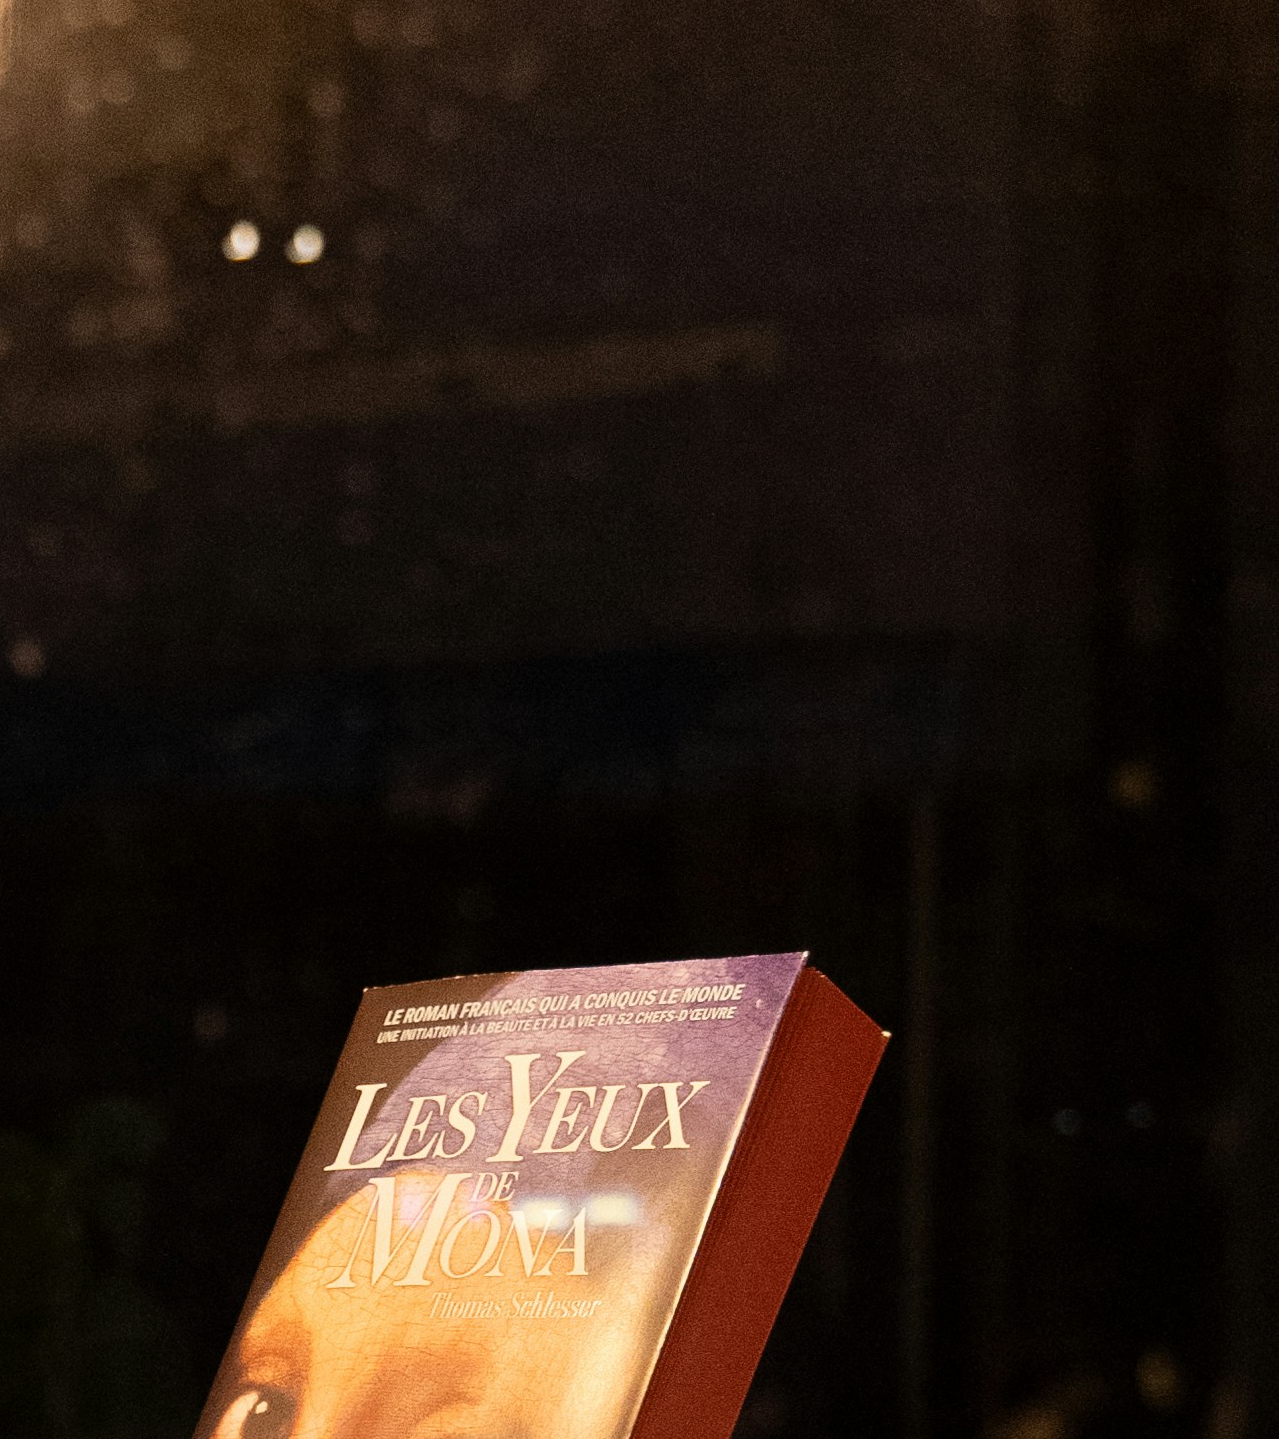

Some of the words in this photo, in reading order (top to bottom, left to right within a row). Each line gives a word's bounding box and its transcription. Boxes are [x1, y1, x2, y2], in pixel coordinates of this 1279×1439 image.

[383, 1008, 405, 1026] LE
[404, 1003, 458, 1025] ROMAN
[459, 997, 538, 1020] FRANÇAIS
[539, 994, 568, 1013] QUI
[570, 994, 583, 1011] A
[584, 989, 657, 1009] CONQUIS
[658, 988, 680, 1006] LE
[680, 983, 745, 1004] MONDE
[376, 1029, 399, 1044] UNE
[399, 1023, 458, 1042] INITIATION
[457, 1021, 469, 1036] À
[469, 1021, 485, 1036] LA
[486, 1016, 534, 1034] BEAUTÉ
[534, 1016, 548, 1030] ET
[557, 1014, 575, 1029] LA
[576, 1012, 597, 1028] VIE
[598, 1012, 617, 1027] EN
[617, 1010, 633, 1026] 52
[634, 1005, 737, 1025] CHEFS-D'ŒUVRE
[470, 1171, 520, 1202] DE
[429, 1291, 503, 1320] Thomas
[506, 1290, 603, 1320] Schlesser
